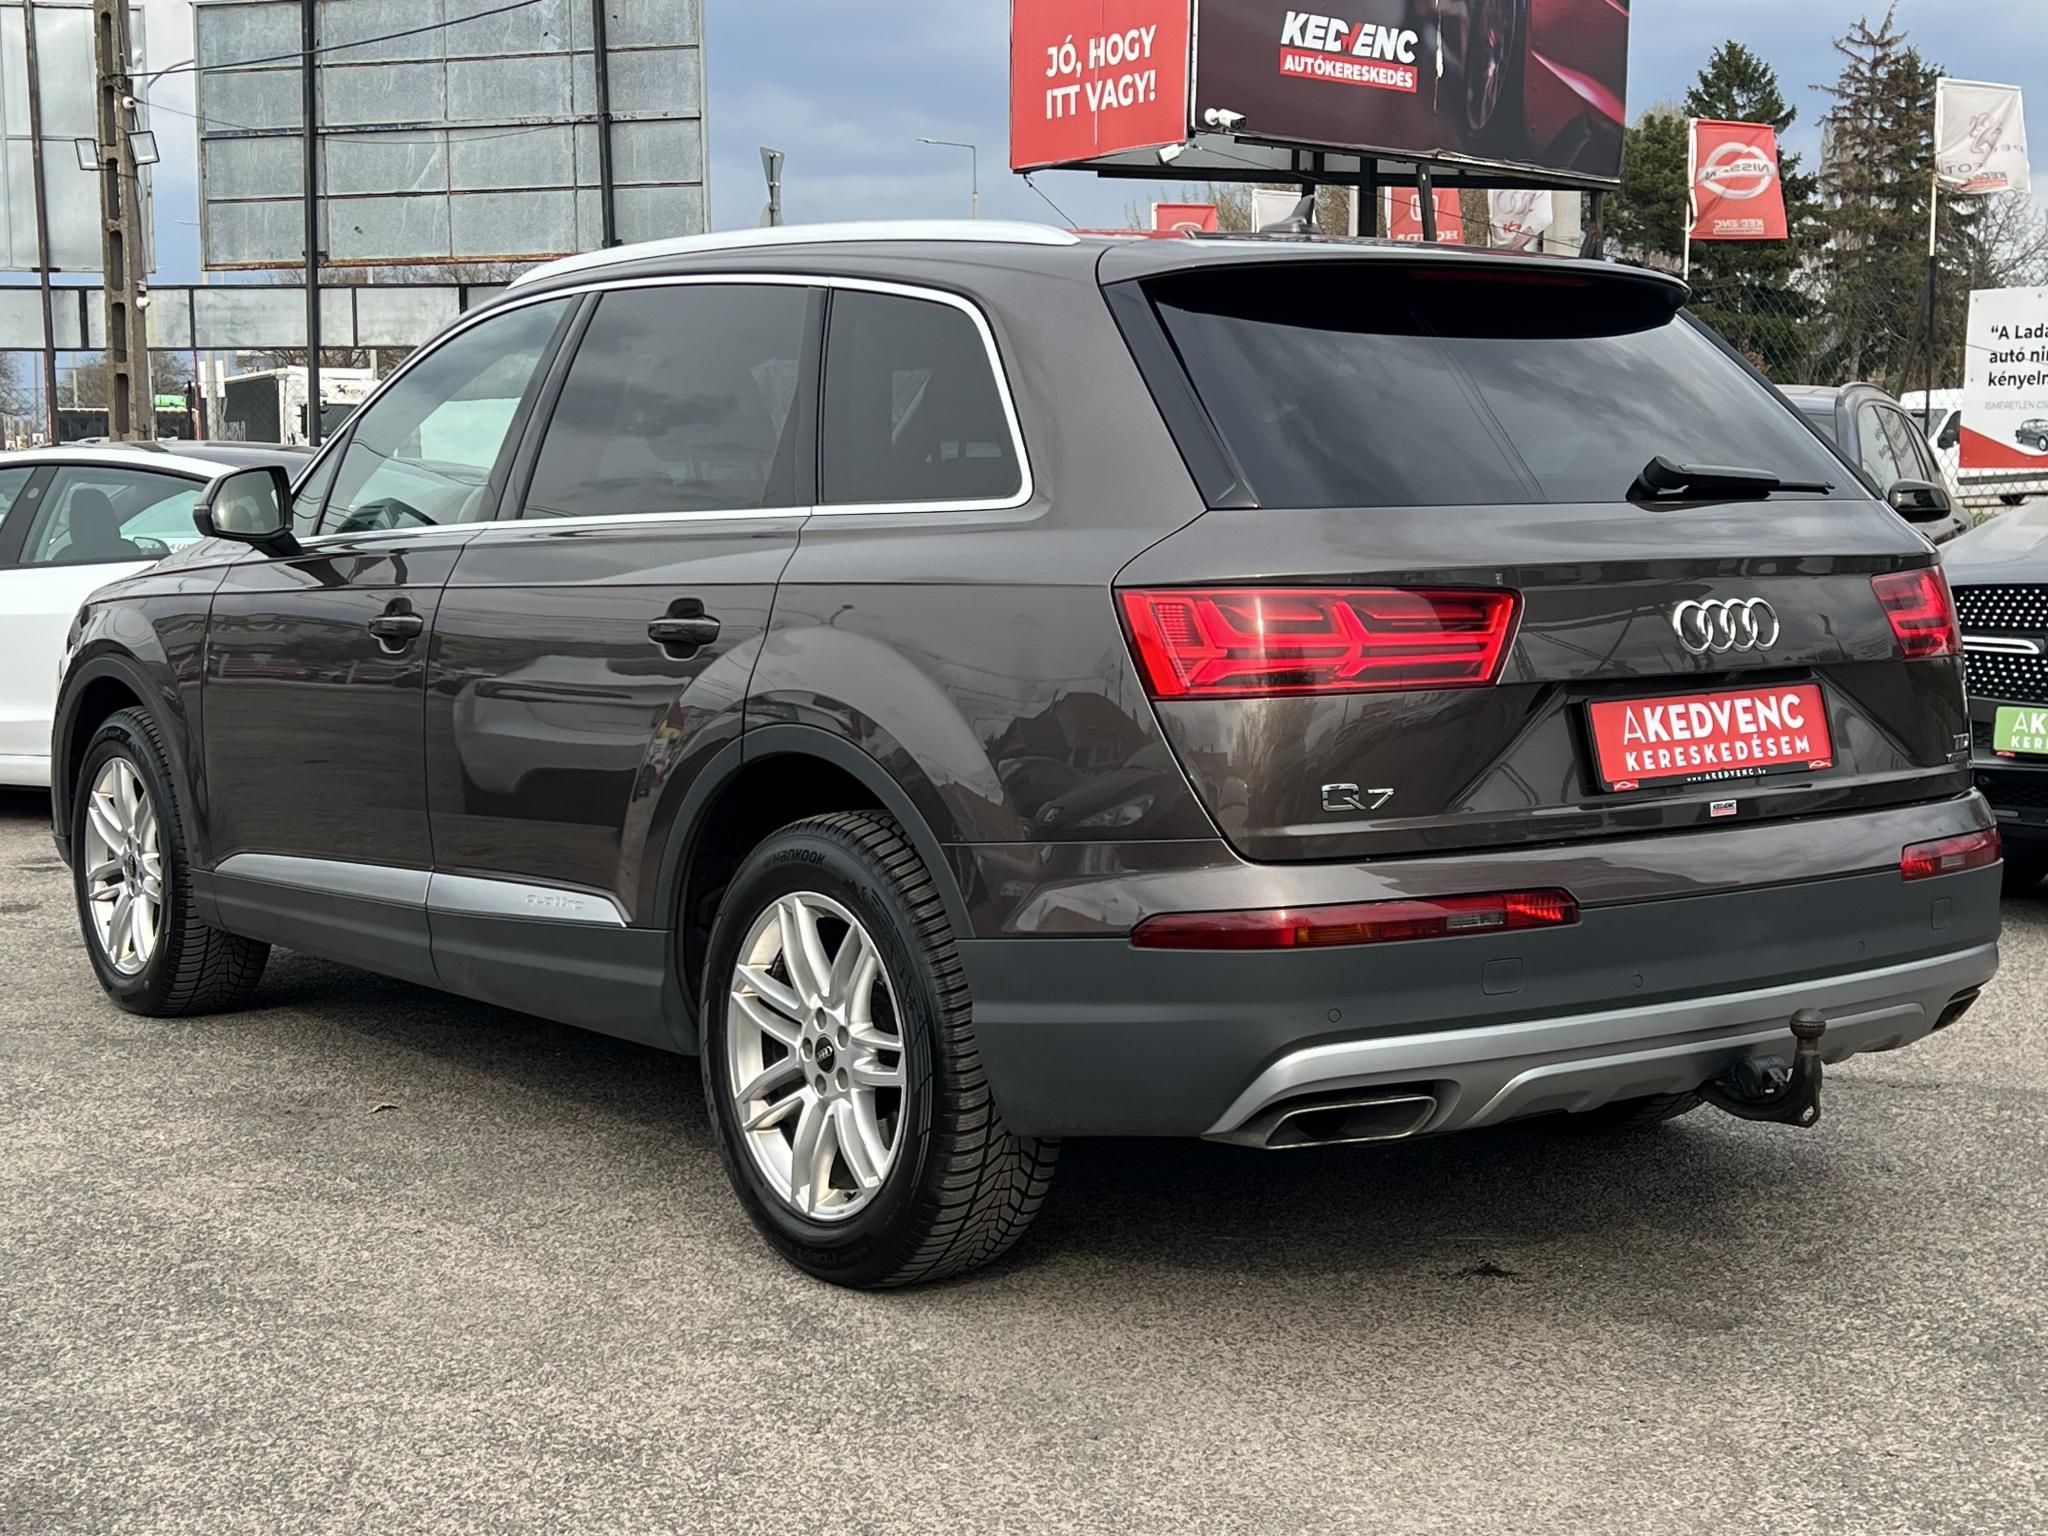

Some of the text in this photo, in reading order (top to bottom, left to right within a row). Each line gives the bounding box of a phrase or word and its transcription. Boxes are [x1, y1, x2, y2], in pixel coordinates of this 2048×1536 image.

[1046, 24, 1157, 78] JÓ, HOGY
[1280, 11, 1419, 64] KEDVENC
[1283, 54, 1414, 89] AUTÓKERESKEDÉS
[1046, 69, 1156, 120] ITT VAGY!
[1989, 345, 2048, 364] autó ni
[1985, 400, 2034, 410] ISMERETLEN
[1623, 693, 1806, 746] AKEDVENC
[2012, 711, 2048, 735] AK
[1625, 733, 1811, 772] KERESKEDÉSEM
[2010, 735, 2048, 750] KER
[1321, 783, 1395, 812] Q7
